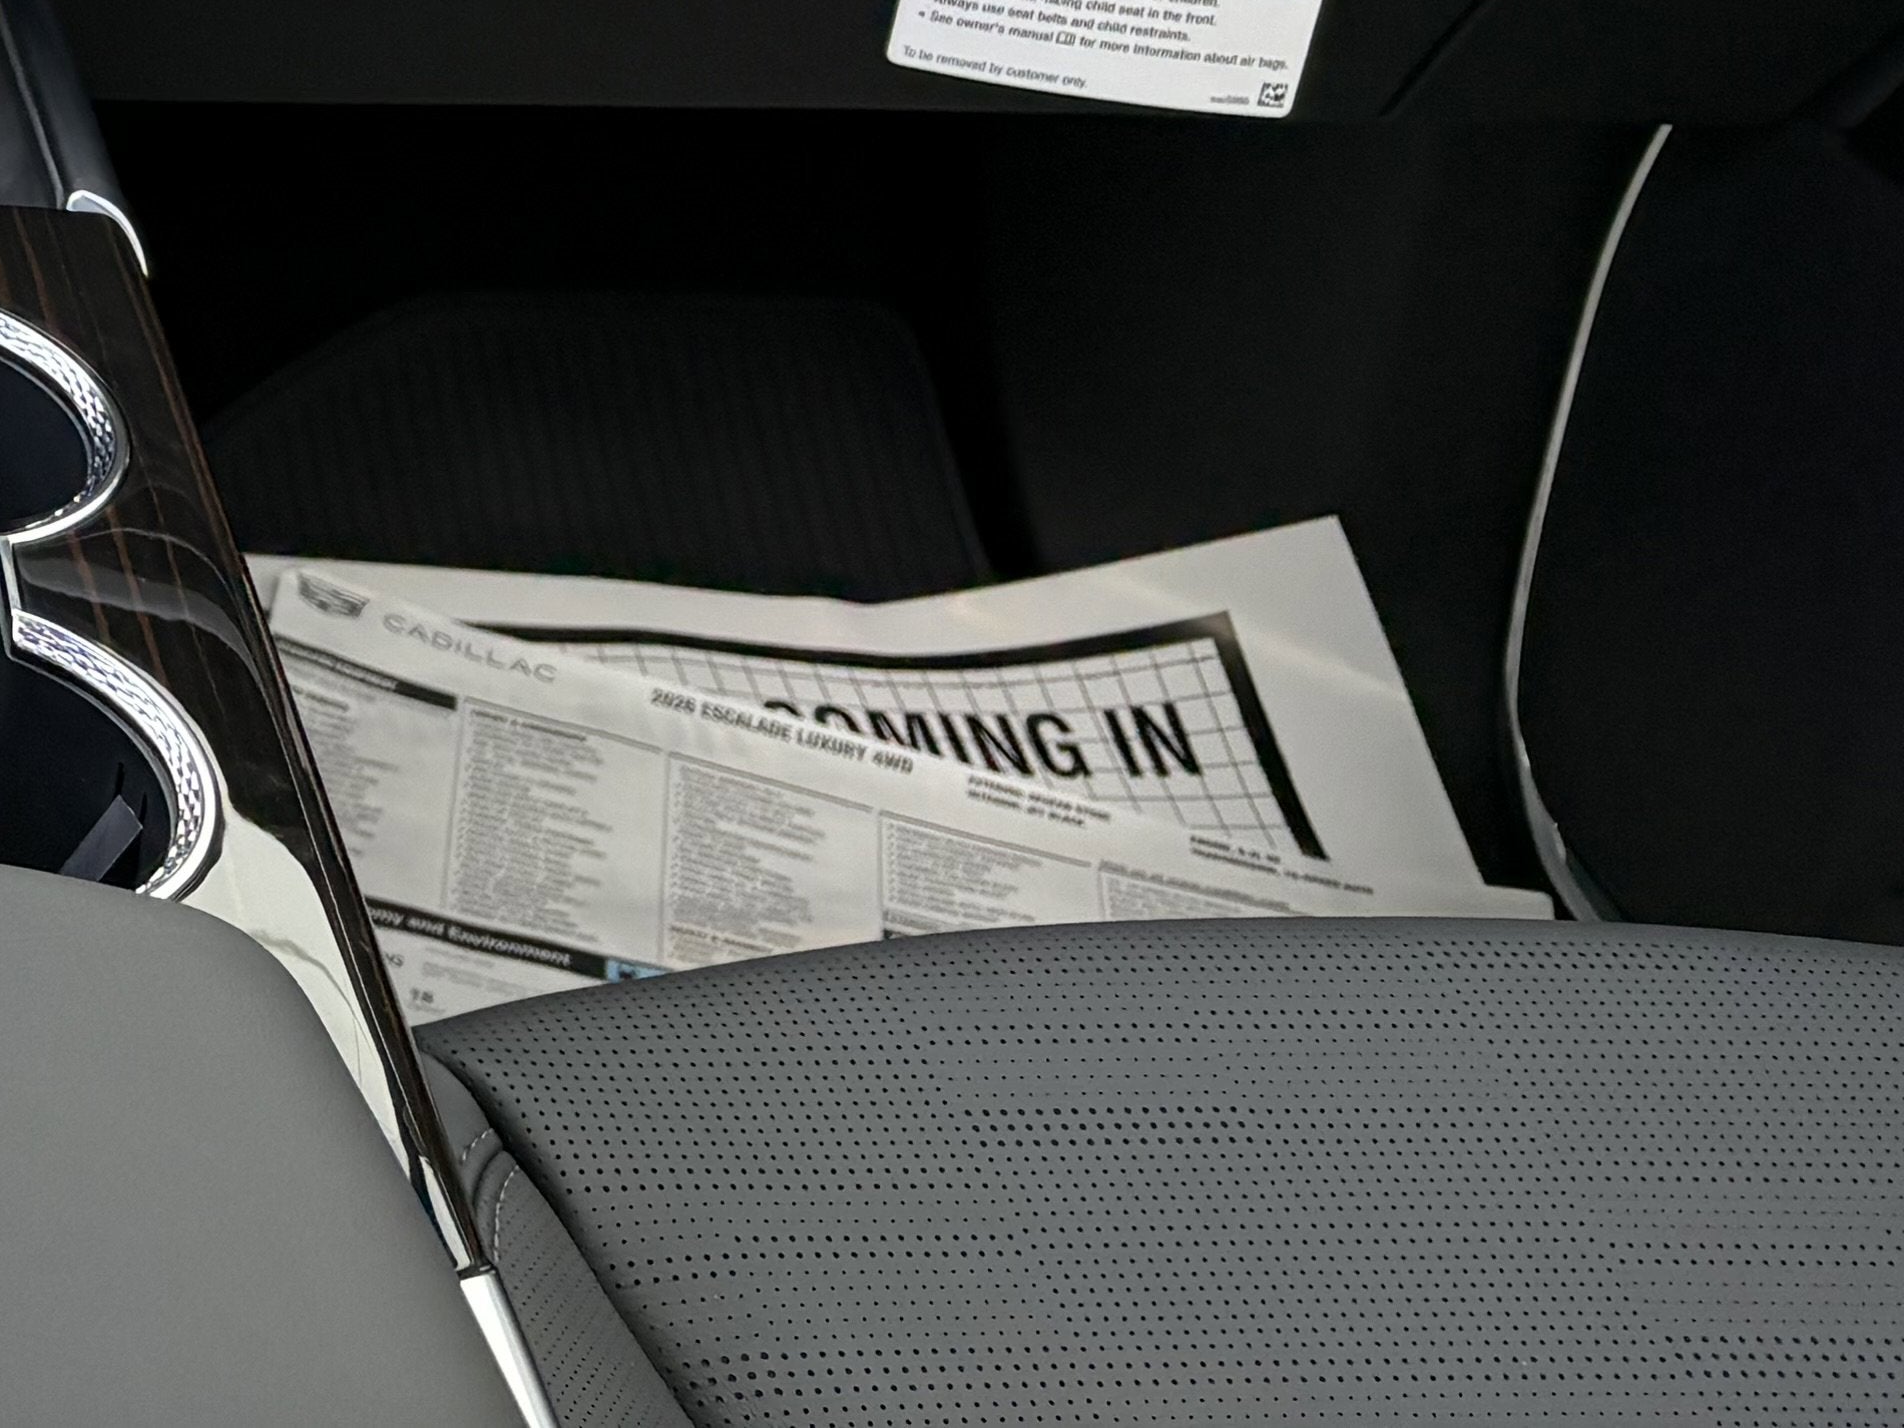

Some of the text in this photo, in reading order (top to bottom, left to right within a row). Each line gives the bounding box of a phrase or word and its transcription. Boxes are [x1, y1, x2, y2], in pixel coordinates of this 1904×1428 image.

[1118, 4, 1145, 18] seat
[1147, 7, 1160, 19] in
[1162, 9, 1183, 22] the
[1185, 11, 1217, 26] front.
[903, 45, 1089, 89] To be removed by customer only.
[382, 612, 560, 684] CADILLAC
[699, 694, 794, 744] ESCALADE
[795, 727, 871, 766] LUXURY
[872, 749, 915, 775] 4WD
[763, 699, 1203, 778] MING IN
[407, 914, 446, 937] and
[448, 924, 573, 968] Environment
